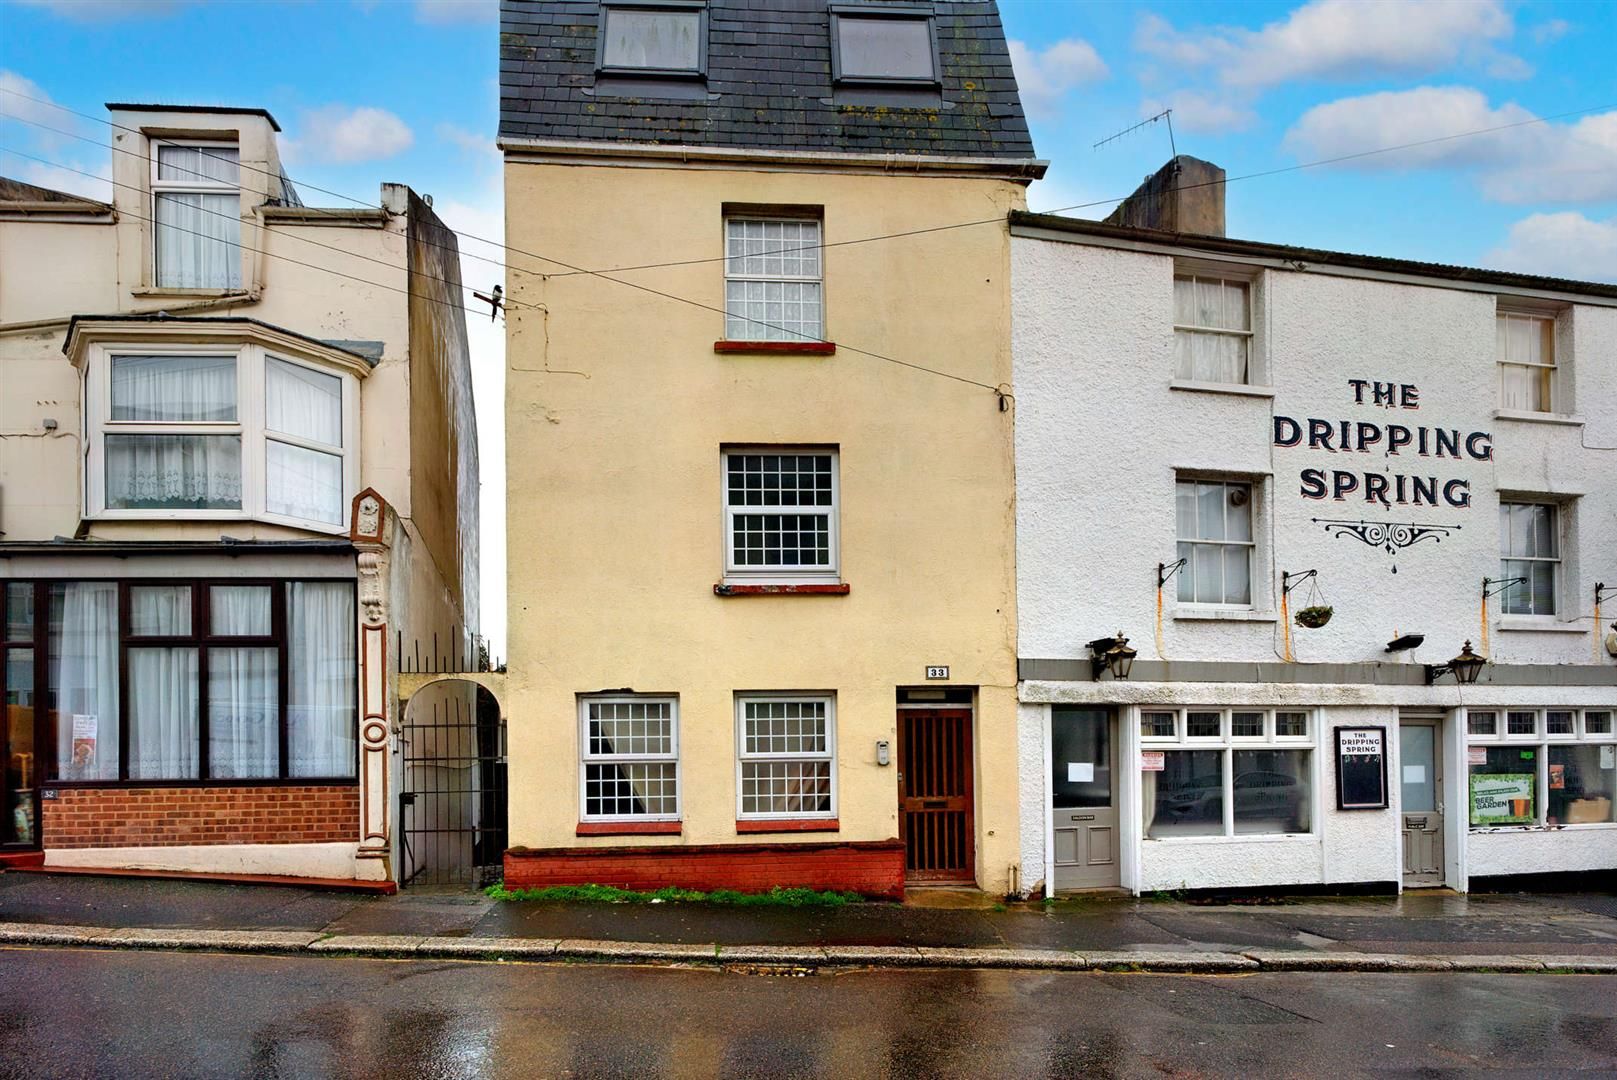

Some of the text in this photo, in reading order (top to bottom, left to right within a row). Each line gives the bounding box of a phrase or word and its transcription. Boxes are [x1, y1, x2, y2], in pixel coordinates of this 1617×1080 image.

[1348, 379, 1420, 409] THE
[1273, 416, 1494, 462] DRIPPING
[1300, 469, 1472, 508] SPRING
[931, 668, 944, 677] 33
[1475, 796, 1495, 804] BEER
[1476, 800, 1507, 810] GARDEN
